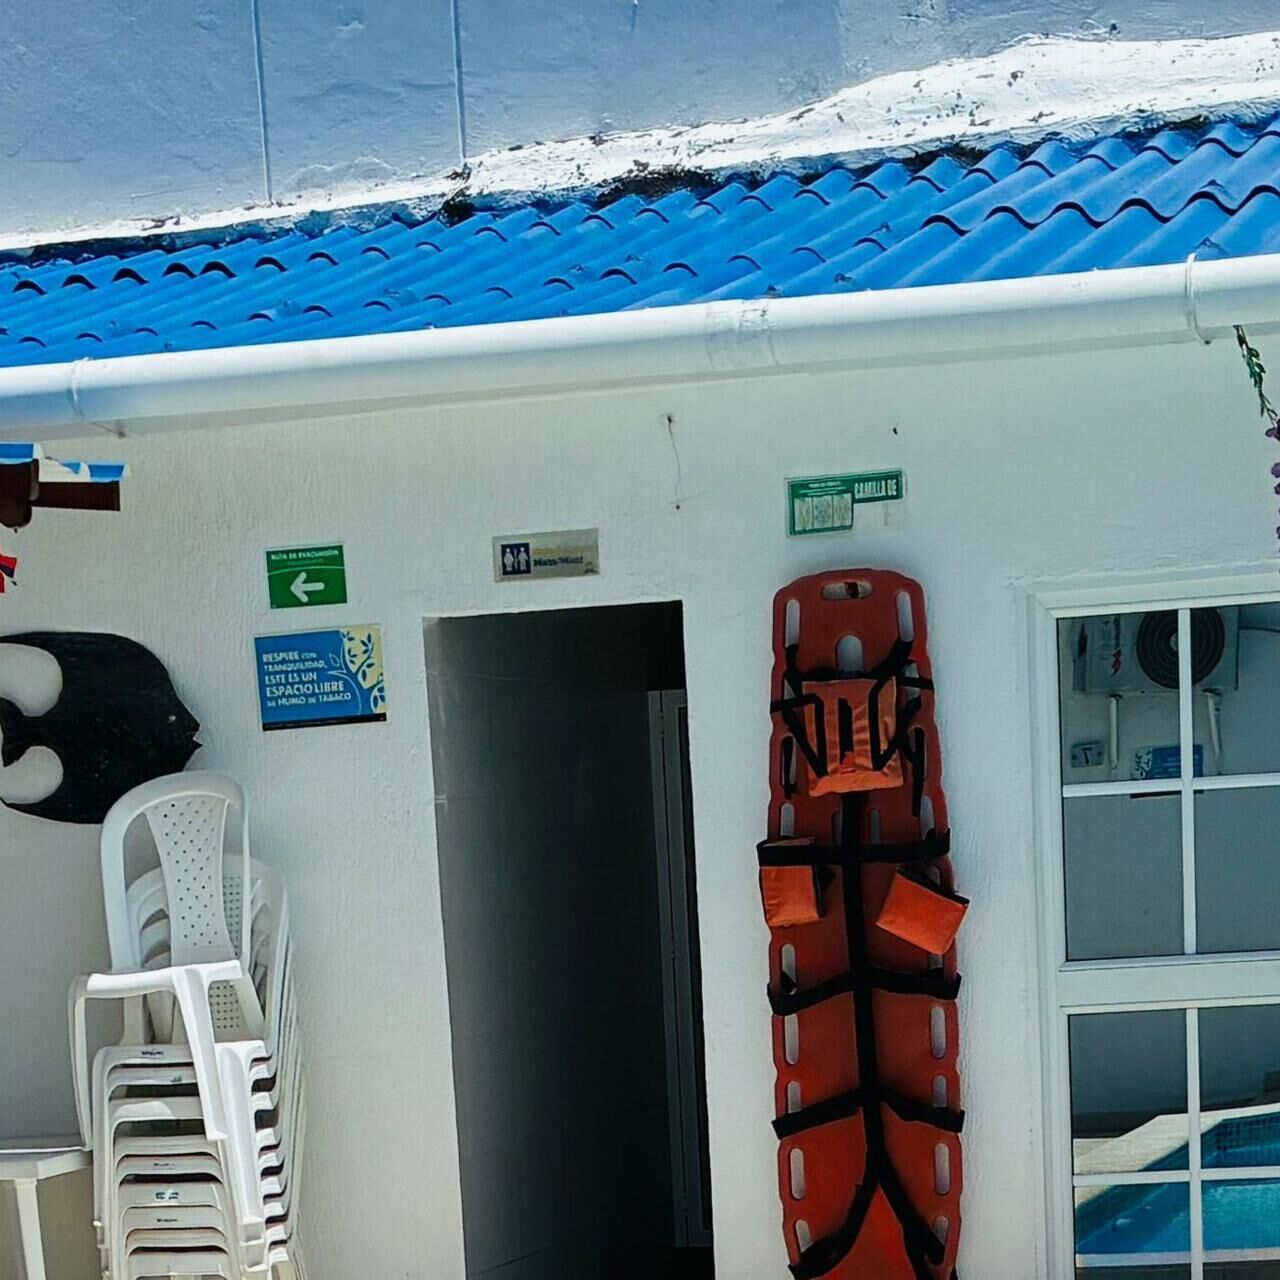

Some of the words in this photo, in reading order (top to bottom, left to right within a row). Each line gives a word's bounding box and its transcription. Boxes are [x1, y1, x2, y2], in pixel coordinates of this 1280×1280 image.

[265, 674, 285, 684] ESTE
[288, 673, 300, 682] ES
[302, 672, 317, 681] UN
[266, 683, 313, 697] ESPACIO
[314, 681, 344, 693] LIBRE
